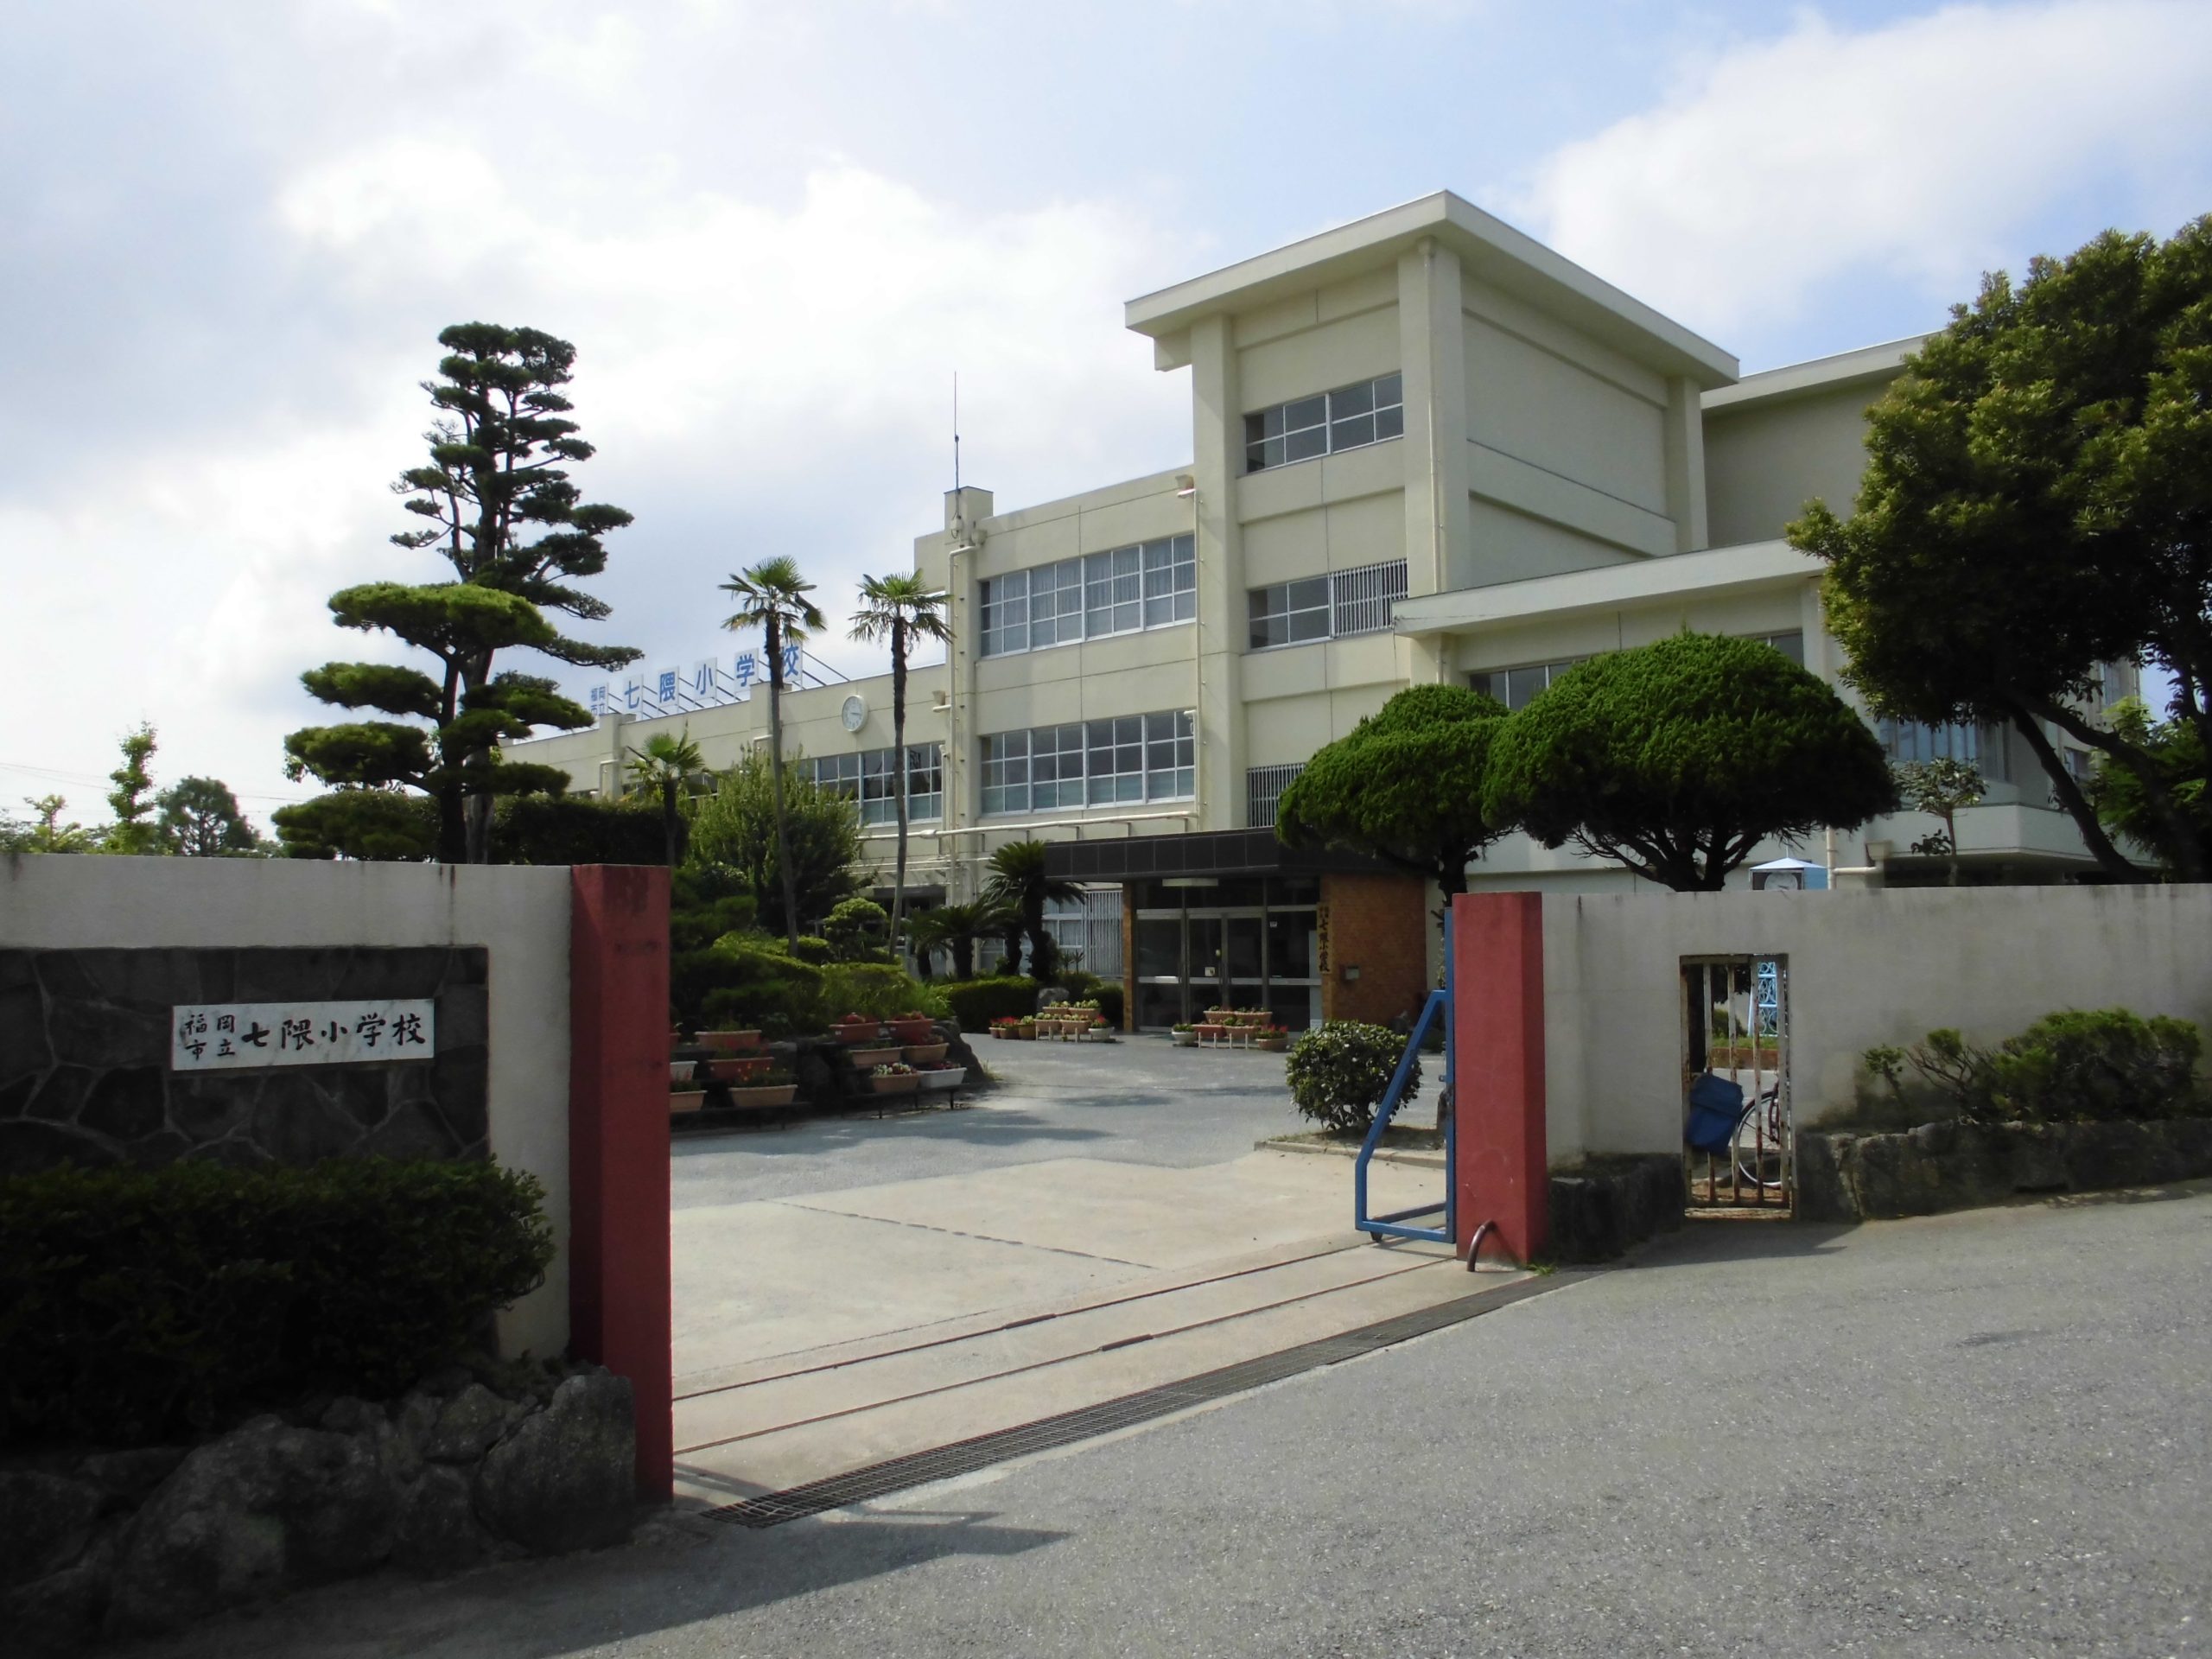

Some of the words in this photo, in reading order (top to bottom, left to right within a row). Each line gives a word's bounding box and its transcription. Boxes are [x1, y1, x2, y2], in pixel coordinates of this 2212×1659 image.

[241, 1012, 426, 1051] 七隈小学校
